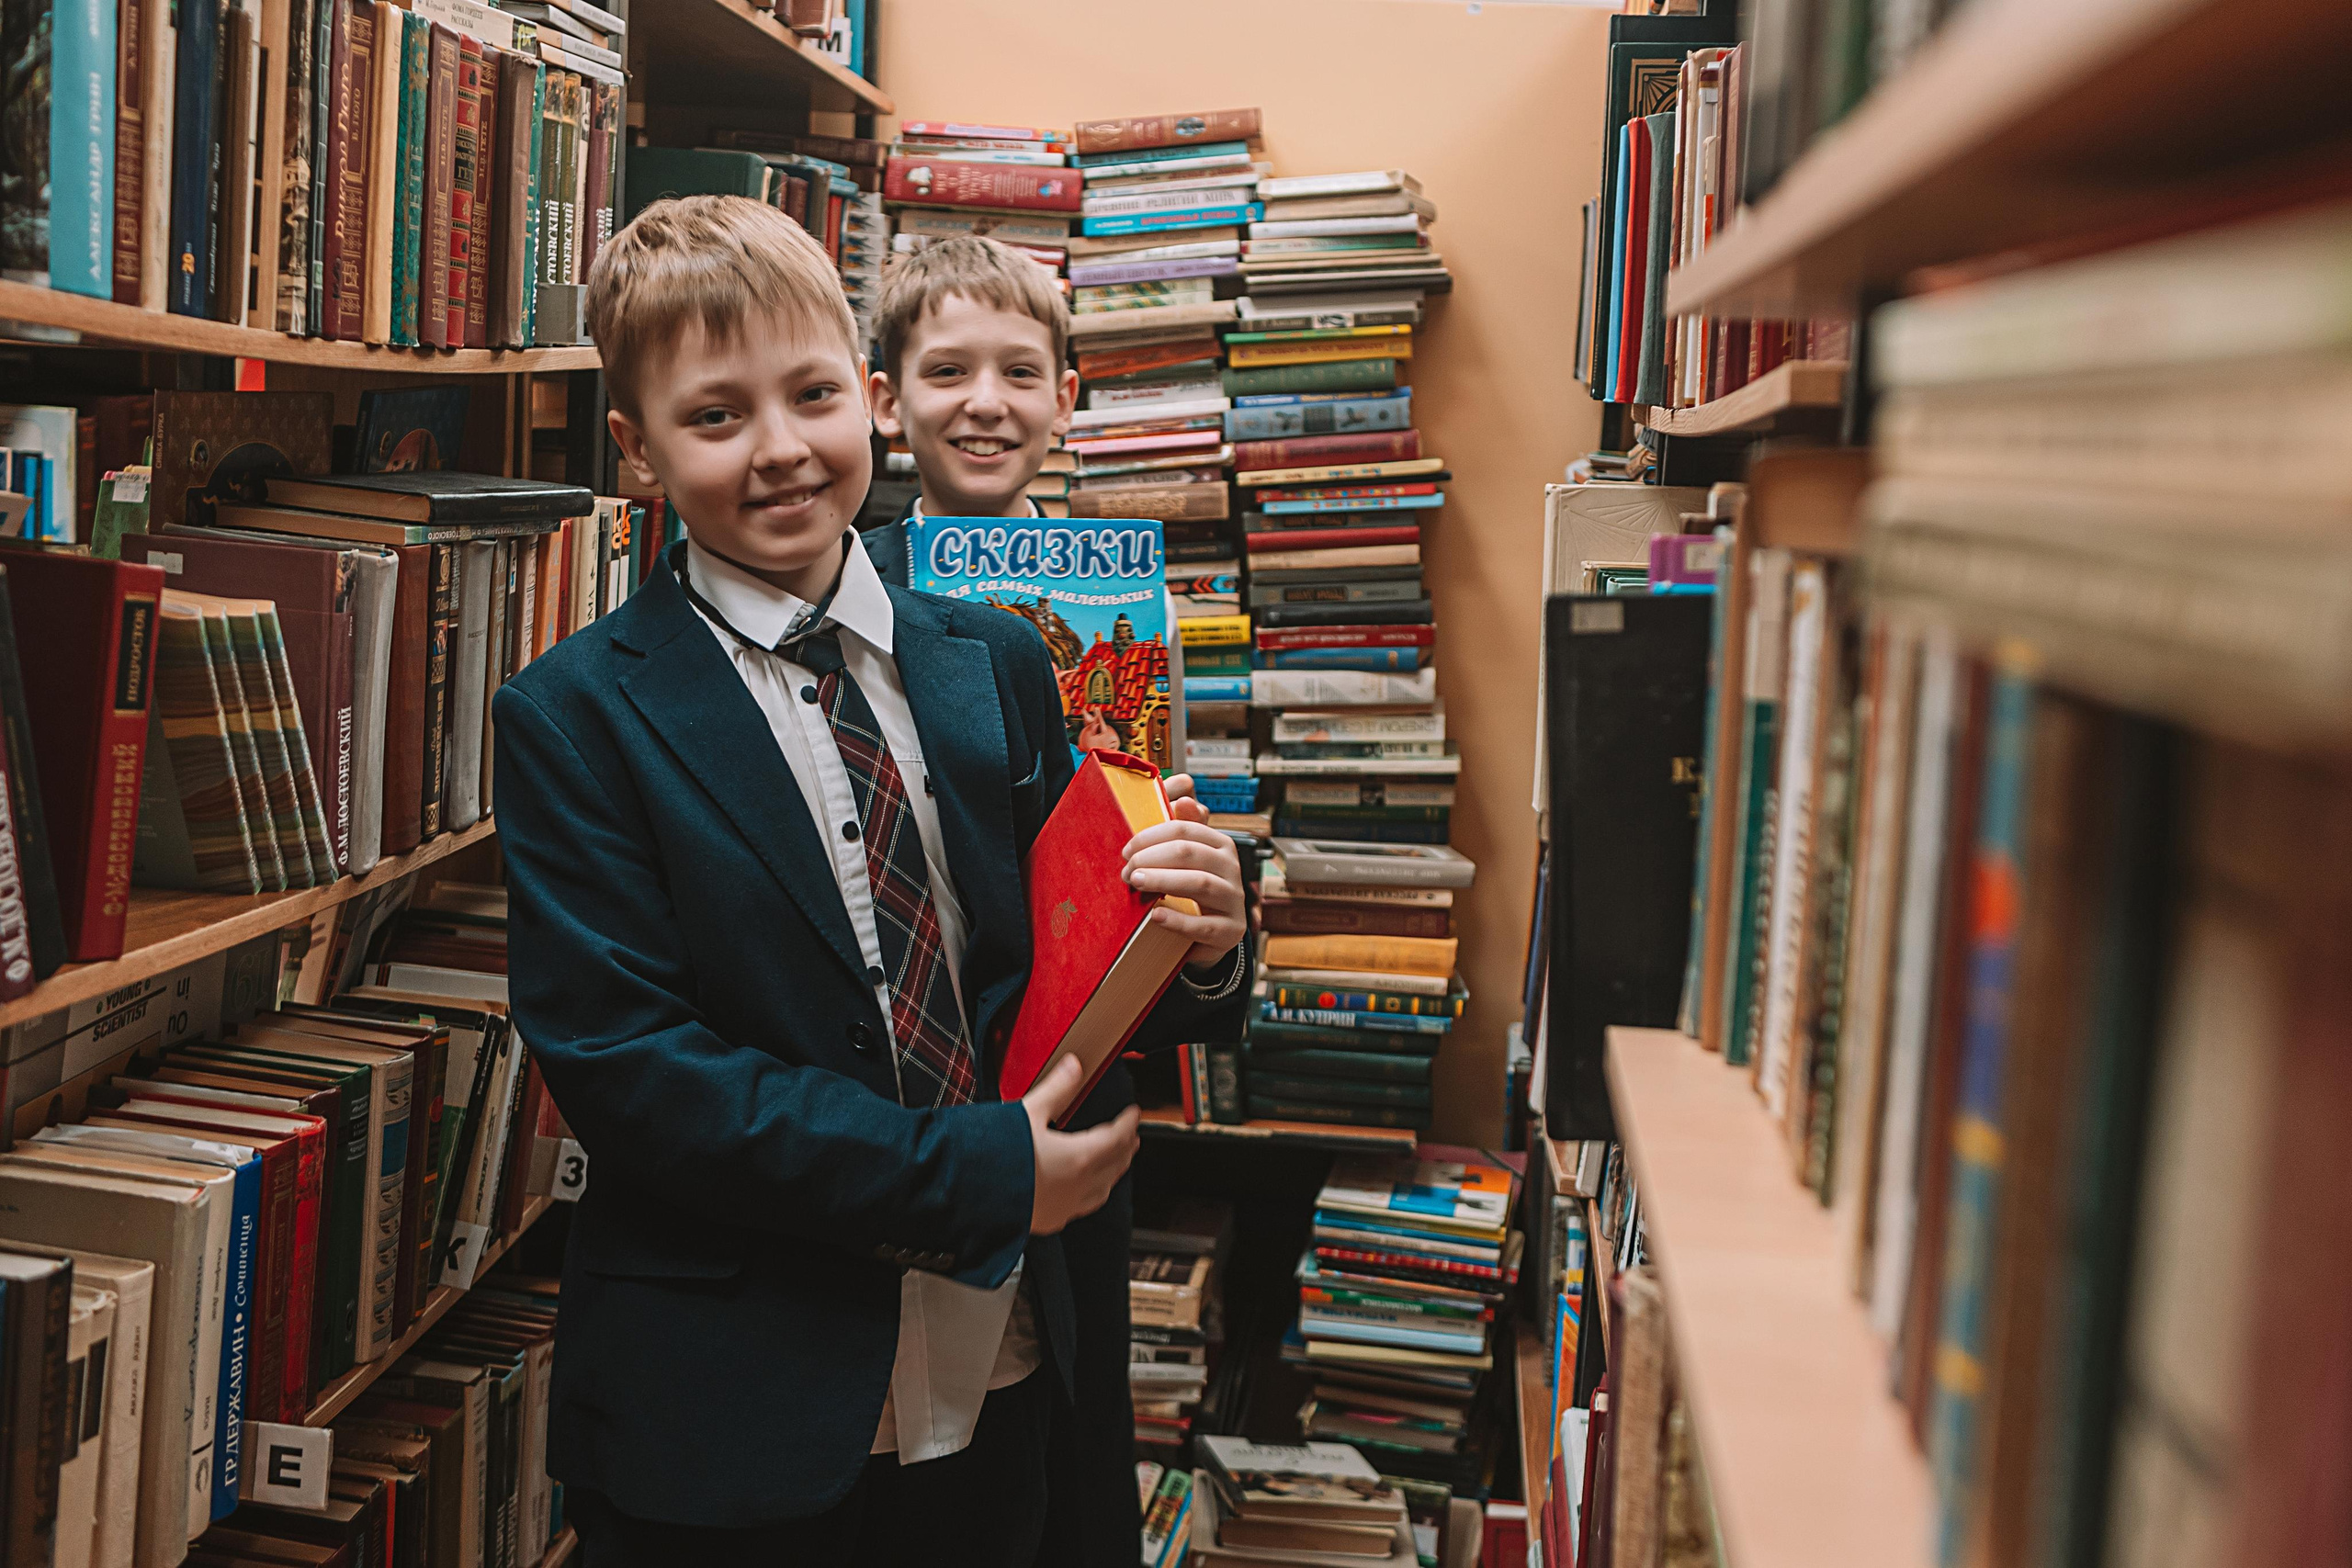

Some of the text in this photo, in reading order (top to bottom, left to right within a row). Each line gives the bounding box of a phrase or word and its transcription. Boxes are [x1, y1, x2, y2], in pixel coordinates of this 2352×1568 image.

[88, 141, 104, 281] АЛЕКСАНДР
[409, 144, 423, 231] ГЕТЕ
[155, 412, 164, 469] СИВКА-БУРКА
[975, 579, 1045, 597] самых
[1046, 588, 1156, 608] маленьких
[125, 608, 147, 703] ПОДРОСТОК
[93, 1002, 148, 1043] SCIENTIST
[106, 980, 143, 1011] YOUNG
